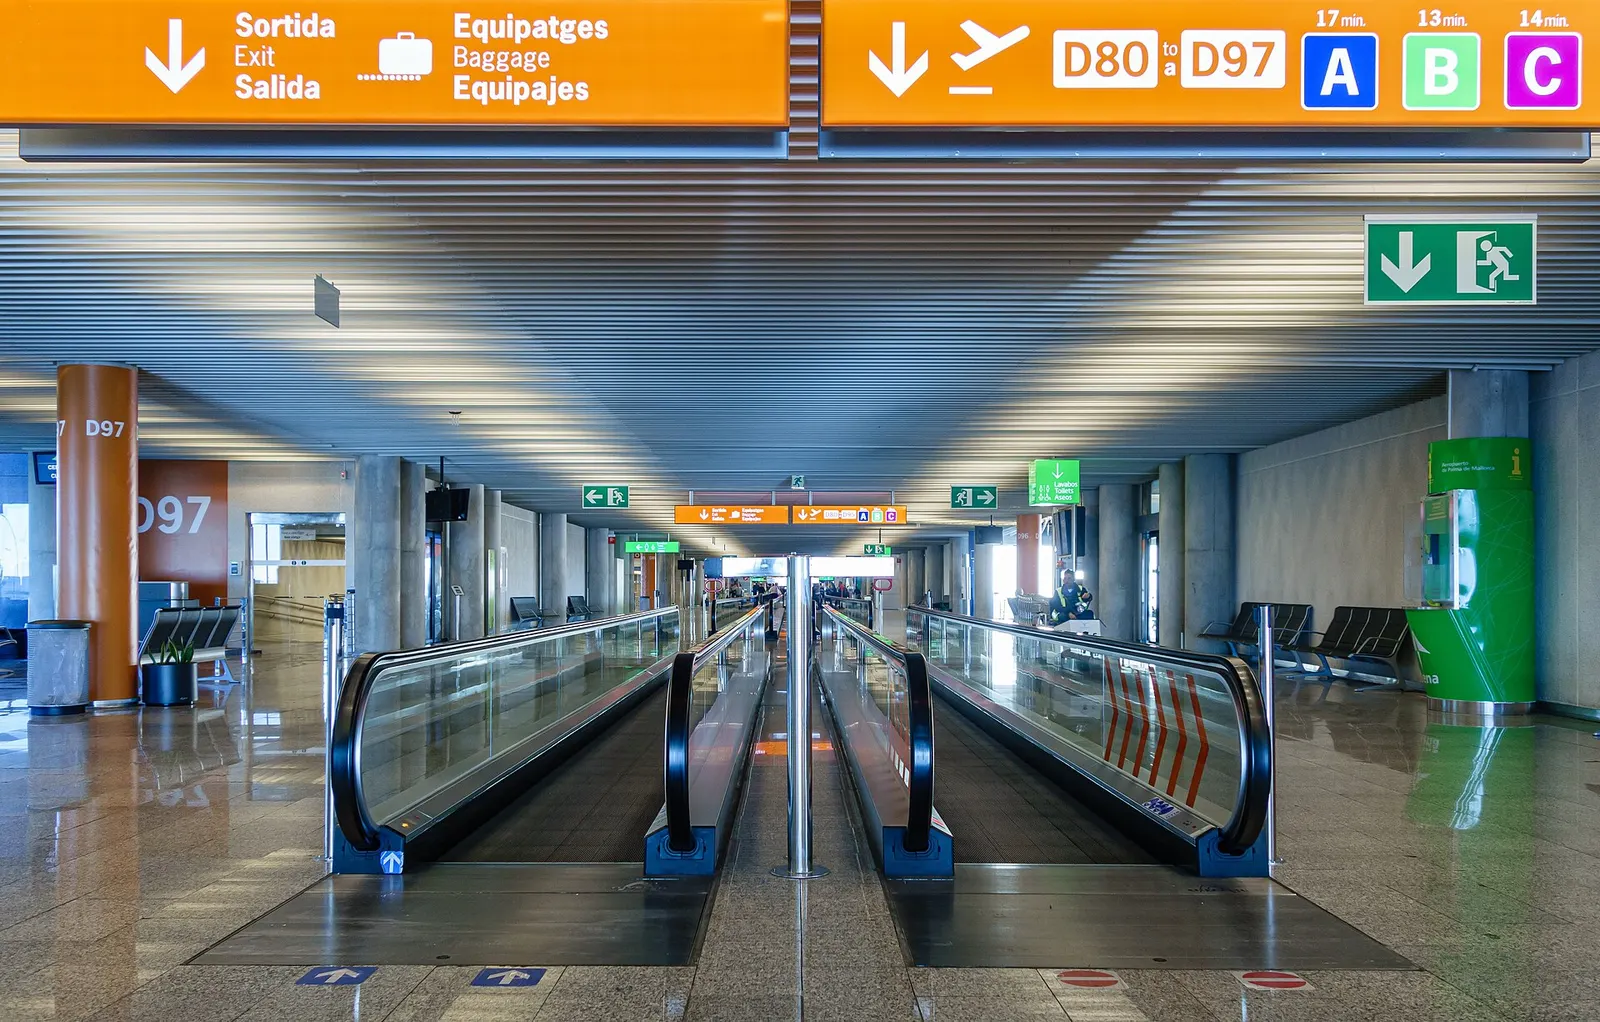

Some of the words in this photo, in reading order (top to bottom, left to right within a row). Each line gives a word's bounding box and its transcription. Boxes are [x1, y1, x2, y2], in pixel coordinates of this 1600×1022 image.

[235, 11, 336, 38] Sortida
[453, 12, 609, 44] Equipatges
[1316, 9, 1339, 27] 17
[1418, 9, 1441, 27] 13
[1519, 9, 1543, 27] 14
[234, 44, 276, 67] Exit
[453, 45, 551, 73] Baggage
[1064, 40, 1149, 78] D80
[1163, 41, 1178, 56] to
[1192, 40, 1276, 78] D97
[1164, 62, 1177, 77] a
[1319, 47, 1360, 96] A
[1424, 47, 1459, 96] B
[1523, 46, 1562, 96] C
[234, 73, 321, 100] Salida
[453, 74, 590, 106] Equipajes
[85, 419, 125, 438] D97
[860, 512, 867, 520] A
[874, 512, 881, 520] B
[887, 512, 895, 520] C
